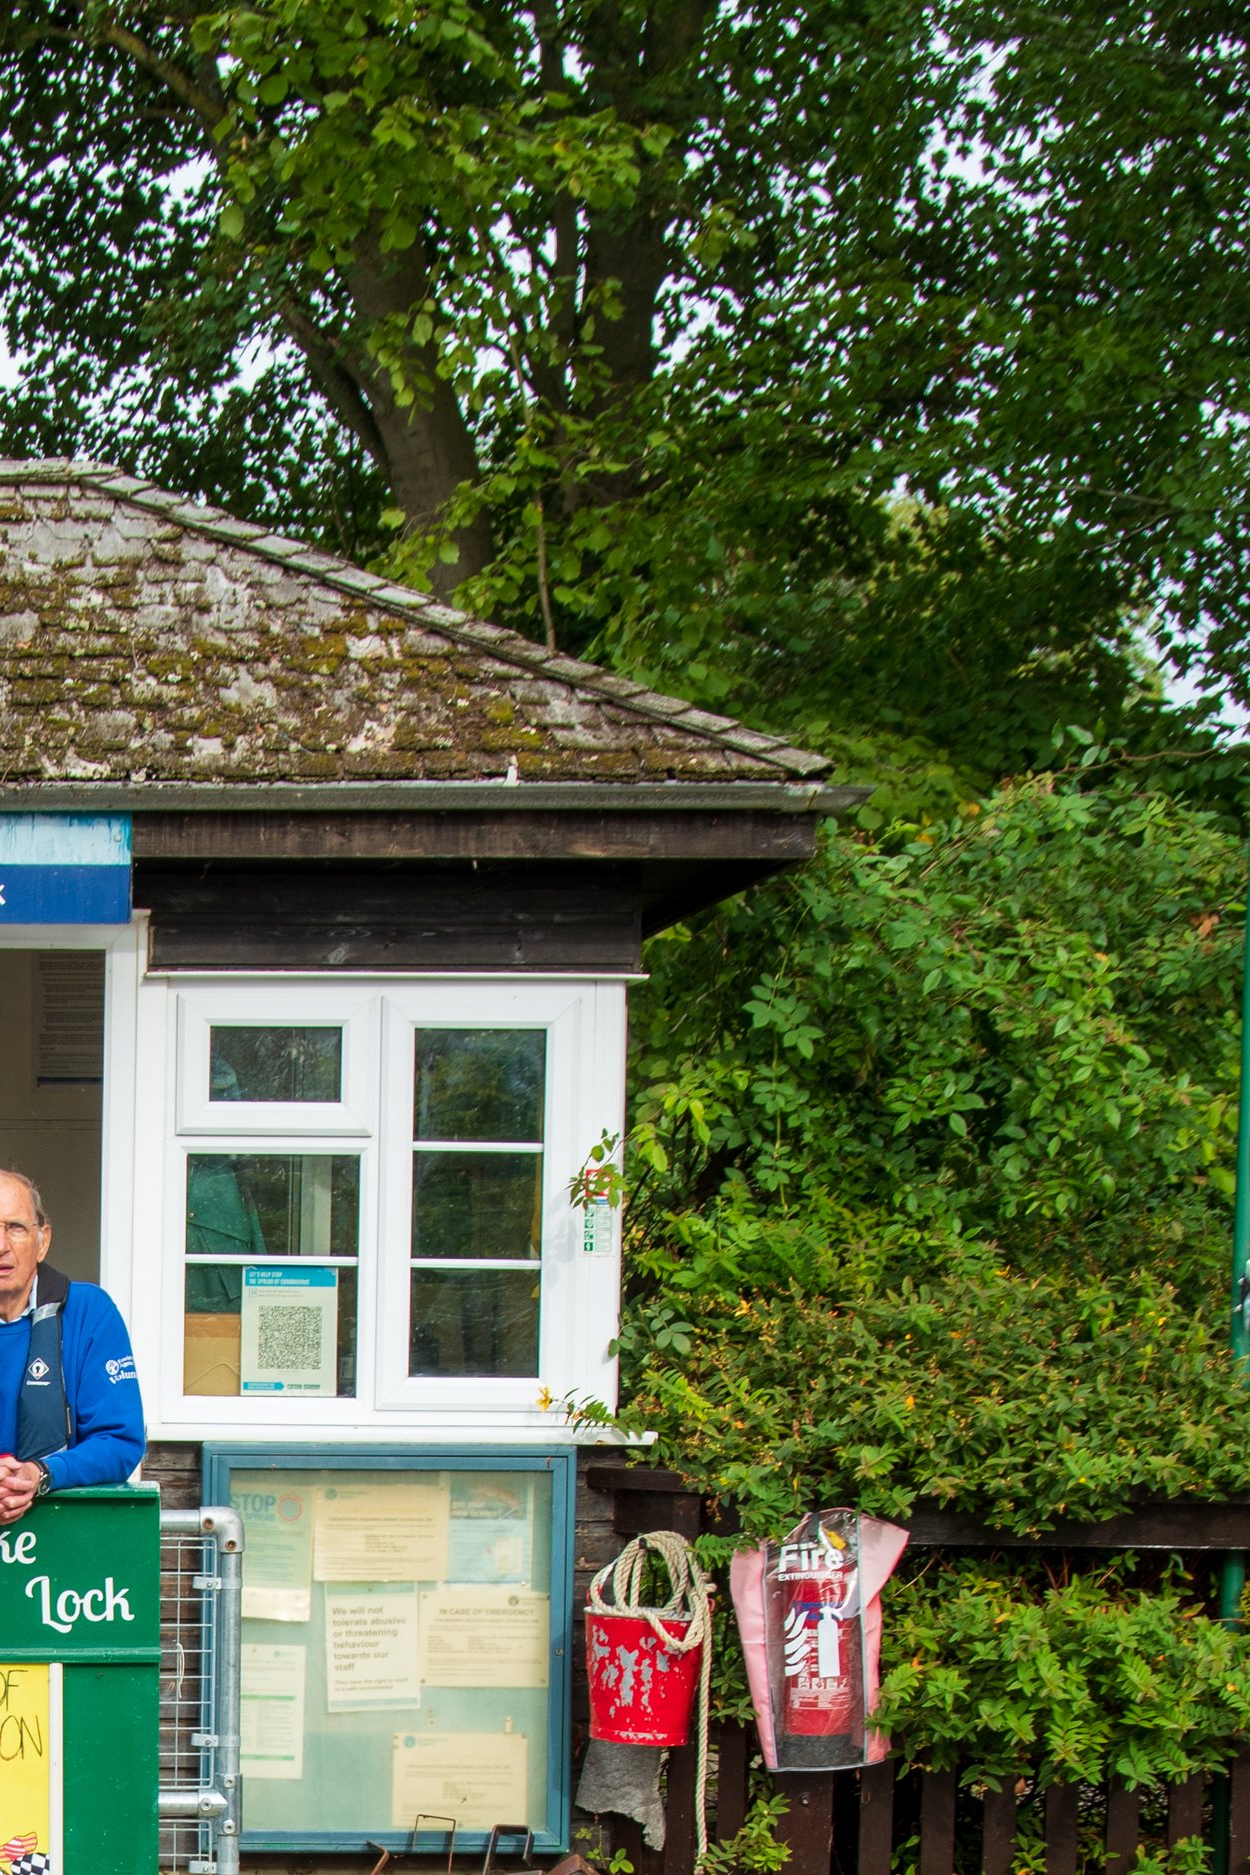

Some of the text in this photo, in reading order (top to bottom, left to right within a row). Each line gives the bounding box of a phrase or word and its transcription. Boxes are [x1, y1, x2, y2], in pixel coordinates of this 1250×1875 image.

[230, 1493, 277, 1512] STOP
[778, 1542, 844, 1573] Fire
[777, 1571, 844, 1582] EXTINGUISHER
[25, 1575, 135, 1634] Lock
[368, 1606, 383, 1614] not
